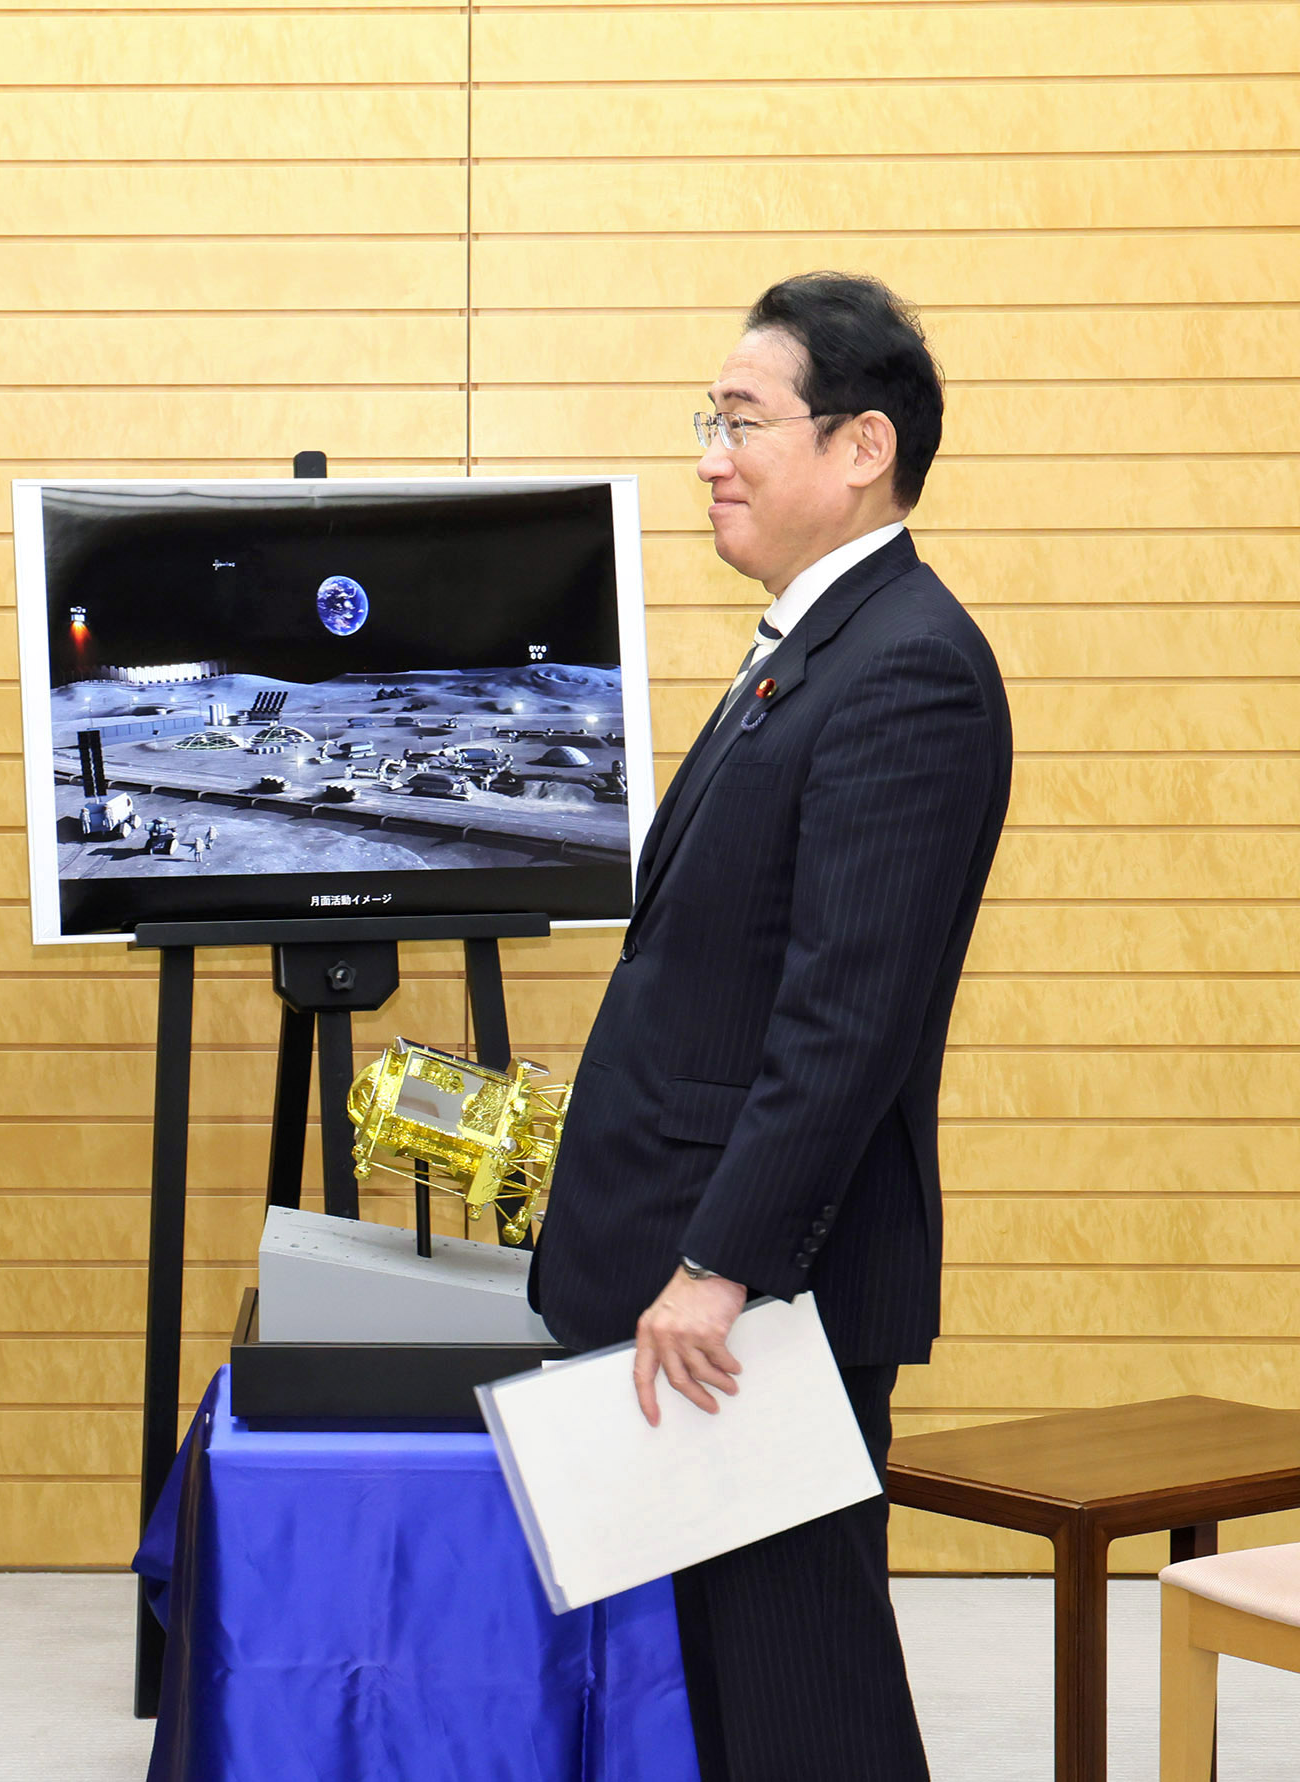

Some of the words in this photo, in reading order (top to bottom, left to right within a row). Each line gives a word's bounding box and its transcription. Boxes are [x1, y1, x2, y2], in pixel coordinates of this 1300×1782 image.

[310, 893, 392, 907] 月面活動イメージ
